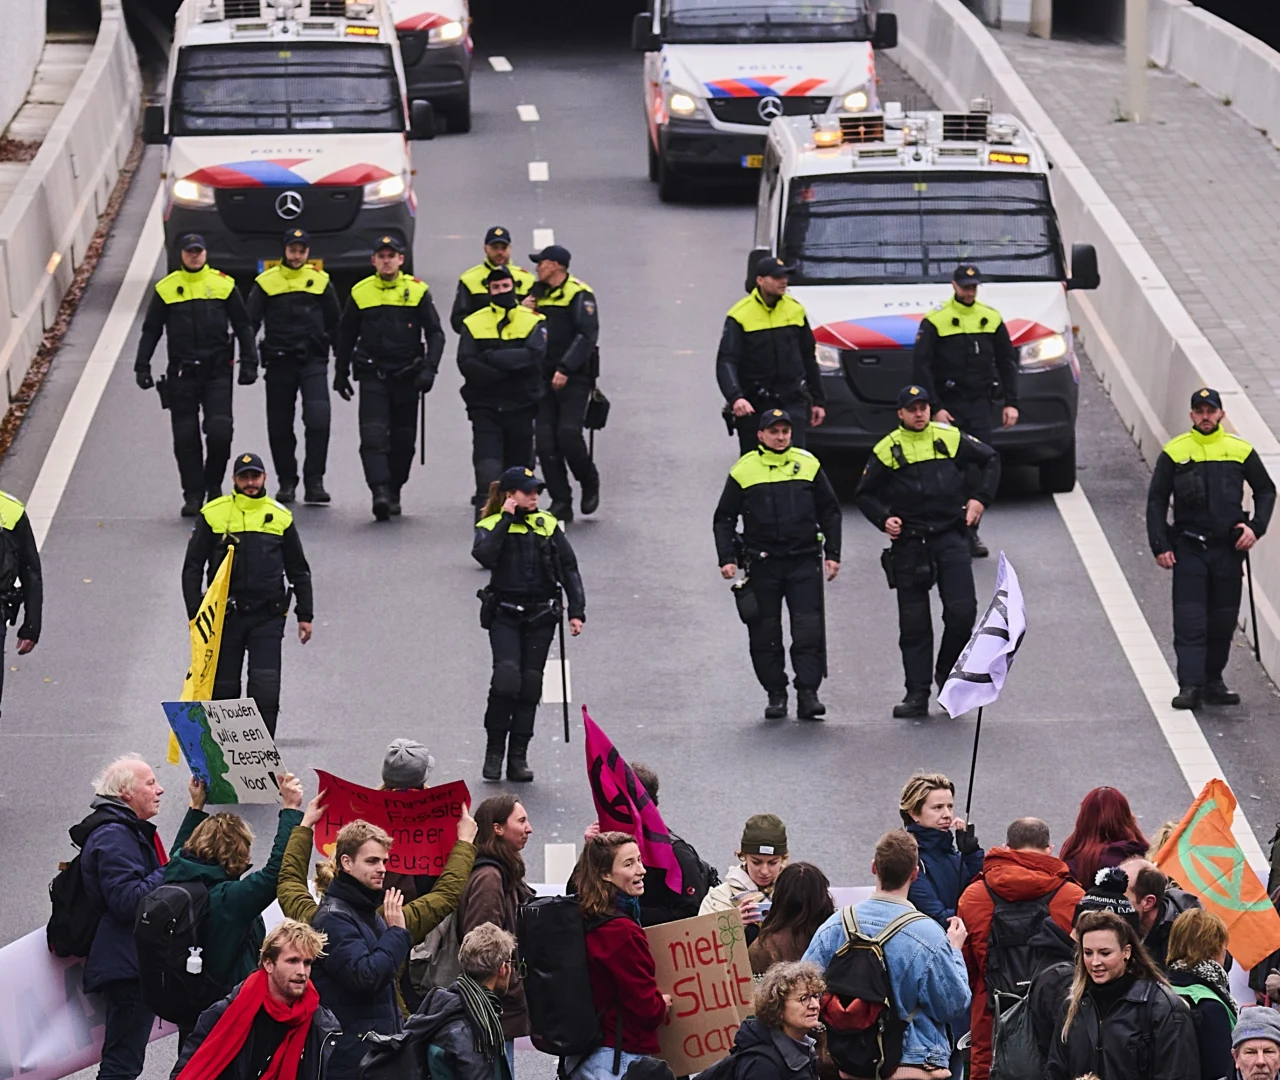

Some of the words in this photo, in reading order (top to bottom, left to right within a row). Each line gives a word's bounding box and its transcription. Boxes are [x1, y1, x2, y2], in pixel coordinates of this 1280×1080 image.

[222, 703, 257, 720] houden
[215, 728, 239, 746] jullie
[243, 728, 265, 742] een
[384, 788, 457, 809] minder
[386, 797, 466, 824] Fossie
[391, 827, 444, 845] meer
[668, 930, 728, 972] niet
